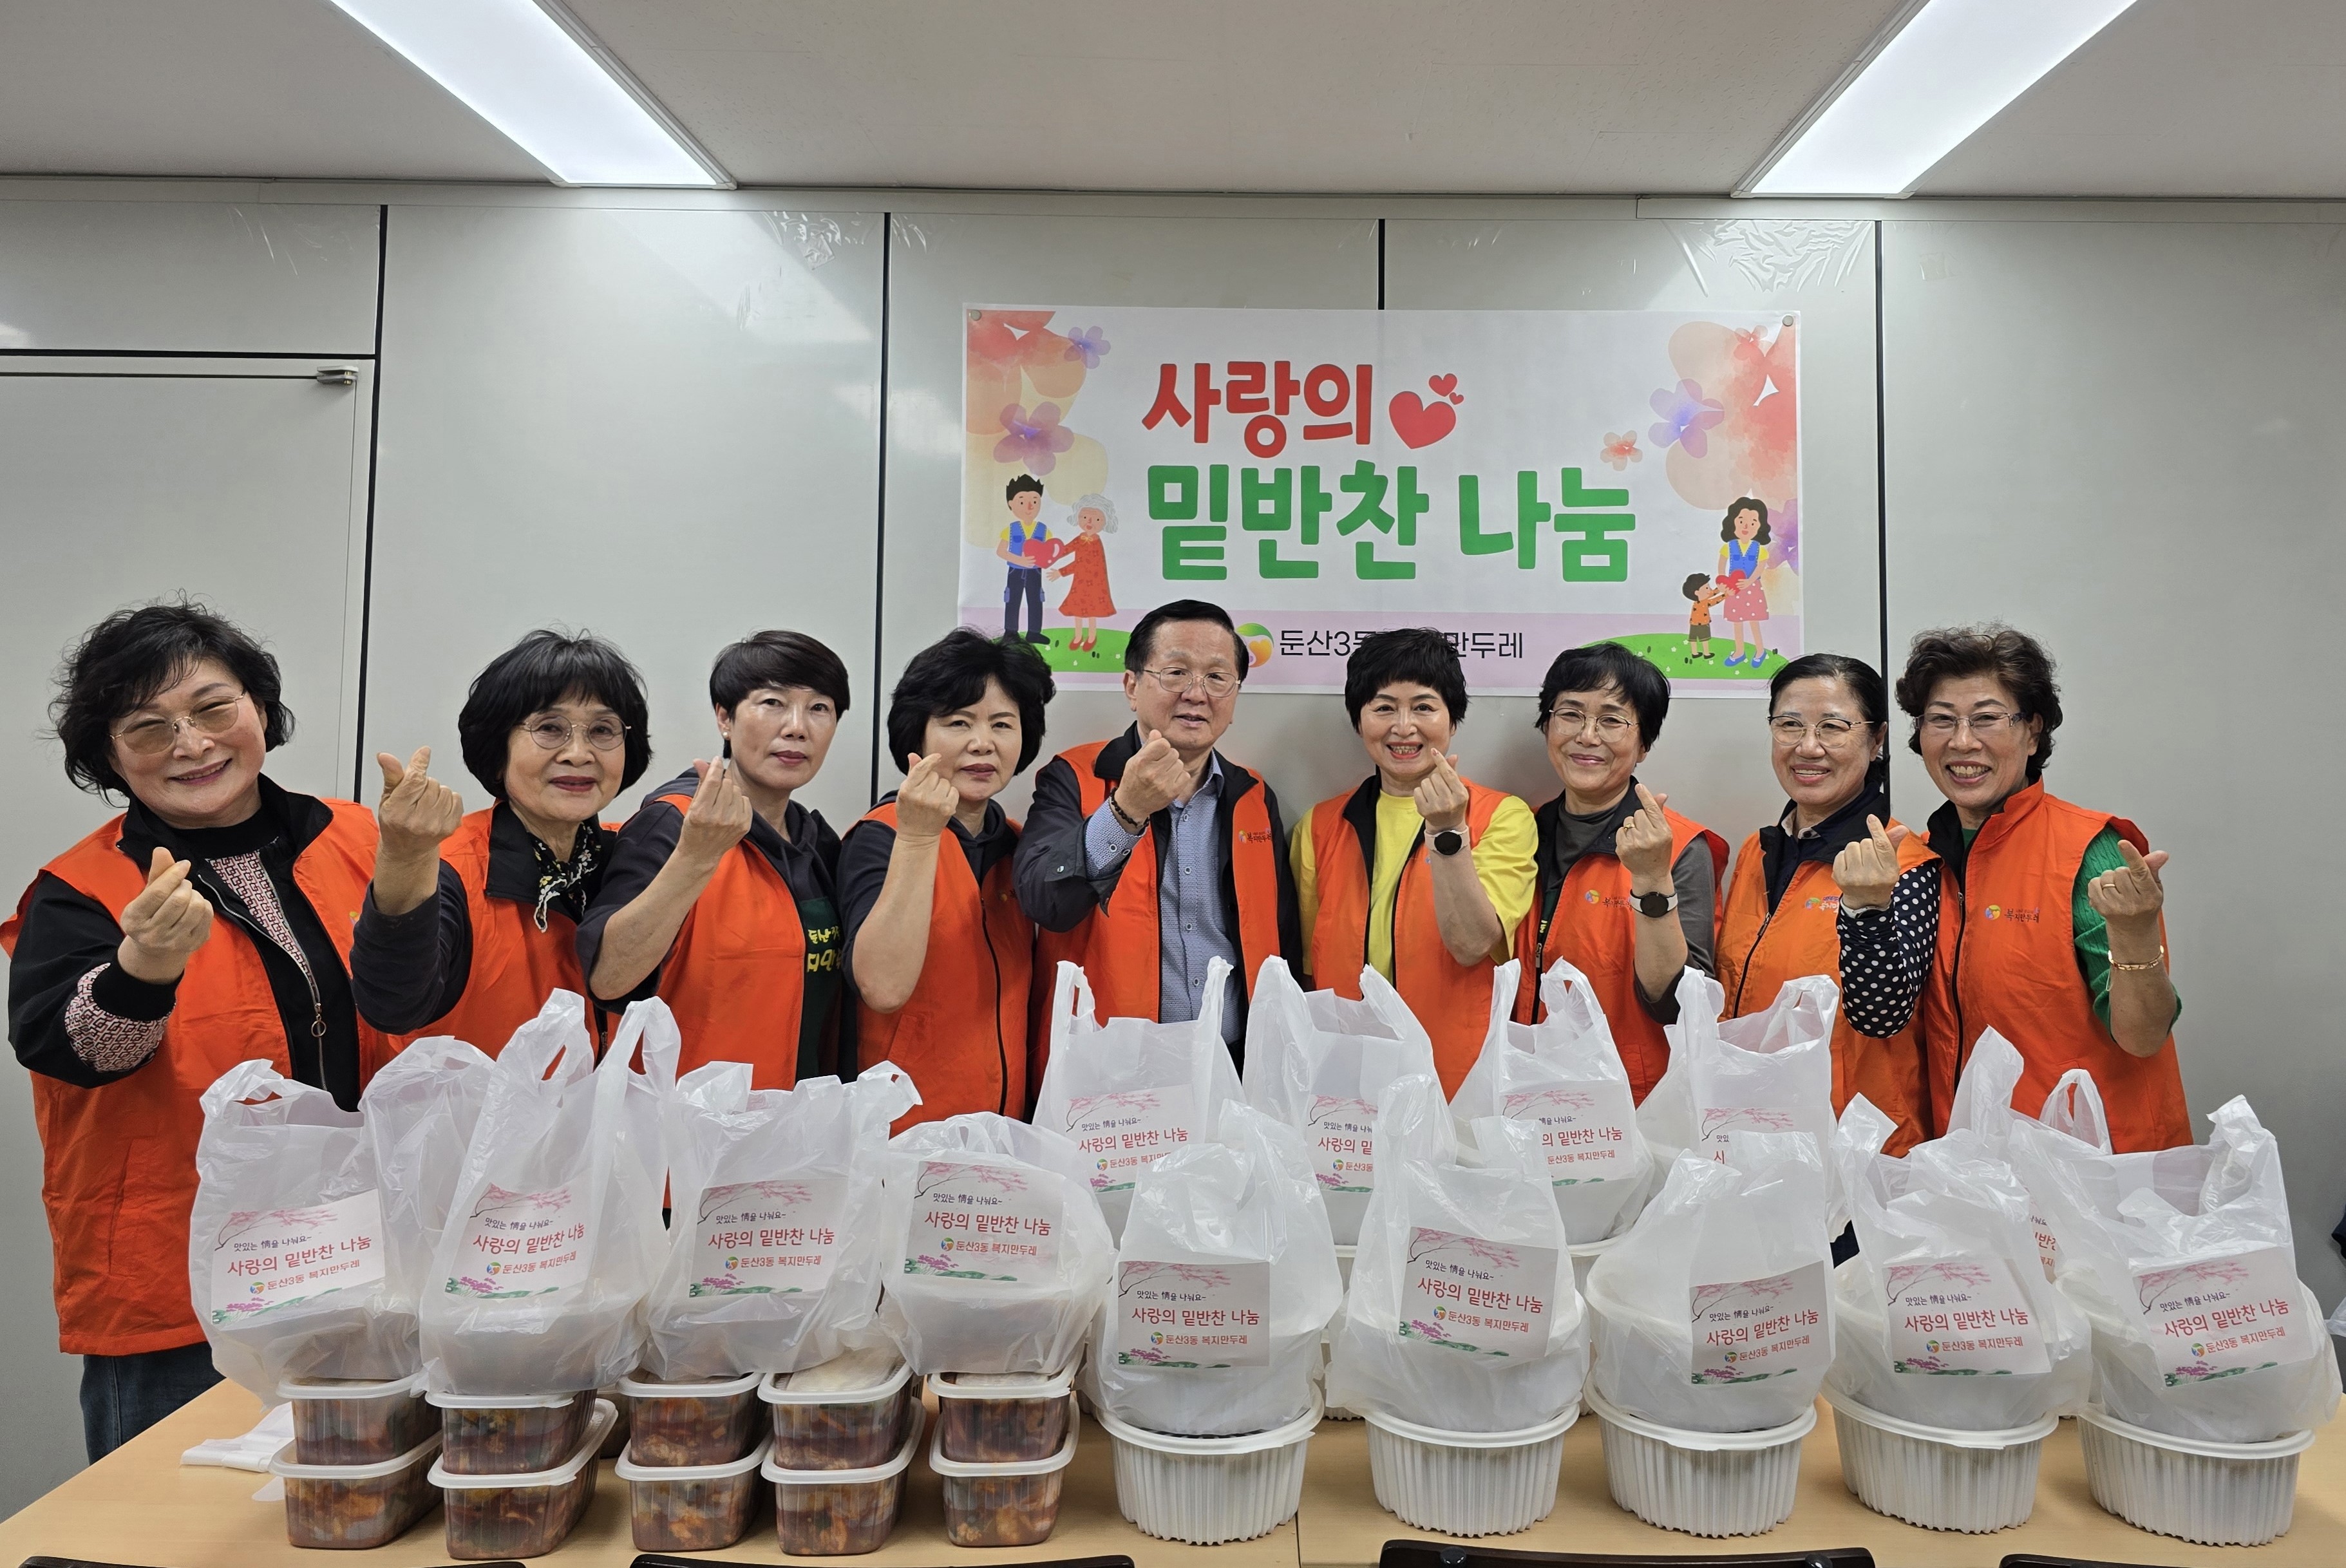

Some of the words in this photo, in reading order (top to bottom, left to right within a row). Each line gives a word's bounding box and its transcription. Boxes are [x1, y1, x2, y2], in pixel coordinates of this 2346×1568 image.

[1142, 361, 1372, 458] 사랑의
[1148, 460, 1428, 581] 밑반찬
[1459, 467, 1636, 582] 나눔
[1444, 632, 1522, 658] 만두레
[1082, 1122, 1100, 1131] 맛있는
[1324, 1122, 1342, 1130] 맛있는
[1079, 1136, 1116, 1153] 사랑의
[1122, 1130, 1159, 1148] 밑반찬
[1164, 1128, 1188, 1142] 나눔
[1558, 1129, 1594, 1146] 밑반찬
[1599, 1127, 1622, 1141] 나눔
[1318, 1137, 1355, 1153] 사랑의
[1110, 1156, 1138, 1168] 둔산3동
[1547, 1154, 1574, 1164] 둔산3동
[1578, 1149, 1614, 1161] 복지만두레
[1346, 1162, 1373, 1171] 둔산3동
[933, 1193, 955, 1203] 맛있는
[484, 1217, 507, 1230] 맛있는
[716, 1214, 738, 1224] 맛있는
[925, 1211, 969, 1230] 사랑의
[976, 1214, 1019, 1234] 밑반찬
[1025, 1218, 1051, 1236] 나눔
[473, 1235, 520, 1254] 사랑의
[527, 1230, 564, 1252] 밑반찬
[568, 1223, 585, 1242] 나눔
[708, 1231, 753, 1249] 사랑의
[760, 1228, 804, 1246] 밑반찬
[809, 1228, 835, 1245] 나눔
[234, 1241, 258, 1252] 맛있는
[956, 1241, 989, 1252] 둔산3동
[992, 1243, 1037, 1256] 복지만두레
[227, 1256, 277, 1277] 사랑의
[285, 1245, 334, 1268] 밑반찬
[340, 1236, 371, 1252] 나눔
[741, 1257, 774, 1267] 둔산3동
[778, 1255, 821, 1266] 복지만두레
[502, 1262, 535, 1274] 둔산3동
[1426, 1260, 1446, 1272] 맛있는
[267, 1274, 305, 1291] 둔산3동
[309, 1260, 359, 1280] 복지만두레
[1137, 1290, 1159, 1299] 맛있는
[1418, 1278, 1461, 1301] 사랑의
[1468, 1287, 1511, 1310] 밑반찬
[1516, 1295, 1543, 1314] 나눔
[1906, 1296, 1927, 1307] 맛있는
[2160, 1301, 2182, 1312] 맛있는
[1132, 1308, 1175, 1324] 사랑의
[1182, 1310, 1225, 1326] 밑반찬
[1231, 1310, 1260, 1325] 나눔
[1448, 1311, 1480, 1327] 둔산3동
[1484, 1318, 1528, 1332] 복지만두레
[1710, 1312, 1730, 1322] 맛있는
[1904, 1313, 1949, 1333] 사랑의
[1953, 1310, 1996, 1330] 밑반찬
[2000, 1308, 2028, 1325] 나눔
[2164, 1314, 2209, 1338] 사랑의
[2211, 1304, 2257, 1330] 밑반찬
[2260, 1298, 2288, 1317] 나눔
[1707, 1327, 1748, 1346] 사랑의
[1754, 1315, 1790, 1339] 밑반찬
[1794, 1308, 1819, 1326] 나눔
[1166, 1335, 1198, 1345] 둔산3동
[1202, 1335, 1247, 1345] 복지만두레
[1942, 1341, 1974, 1351] 둔산3동
[1978, 1336, 2023, 1348] 복지만두레
[2206, 1337, 2238, 1353] 둔산3동
[2240, 1326, 2285, 1345] 복지만두레
[1740, 1346, 1768, 1361] 둔산3동
[1772, 1334, 1810, 1353] 복지만두레
